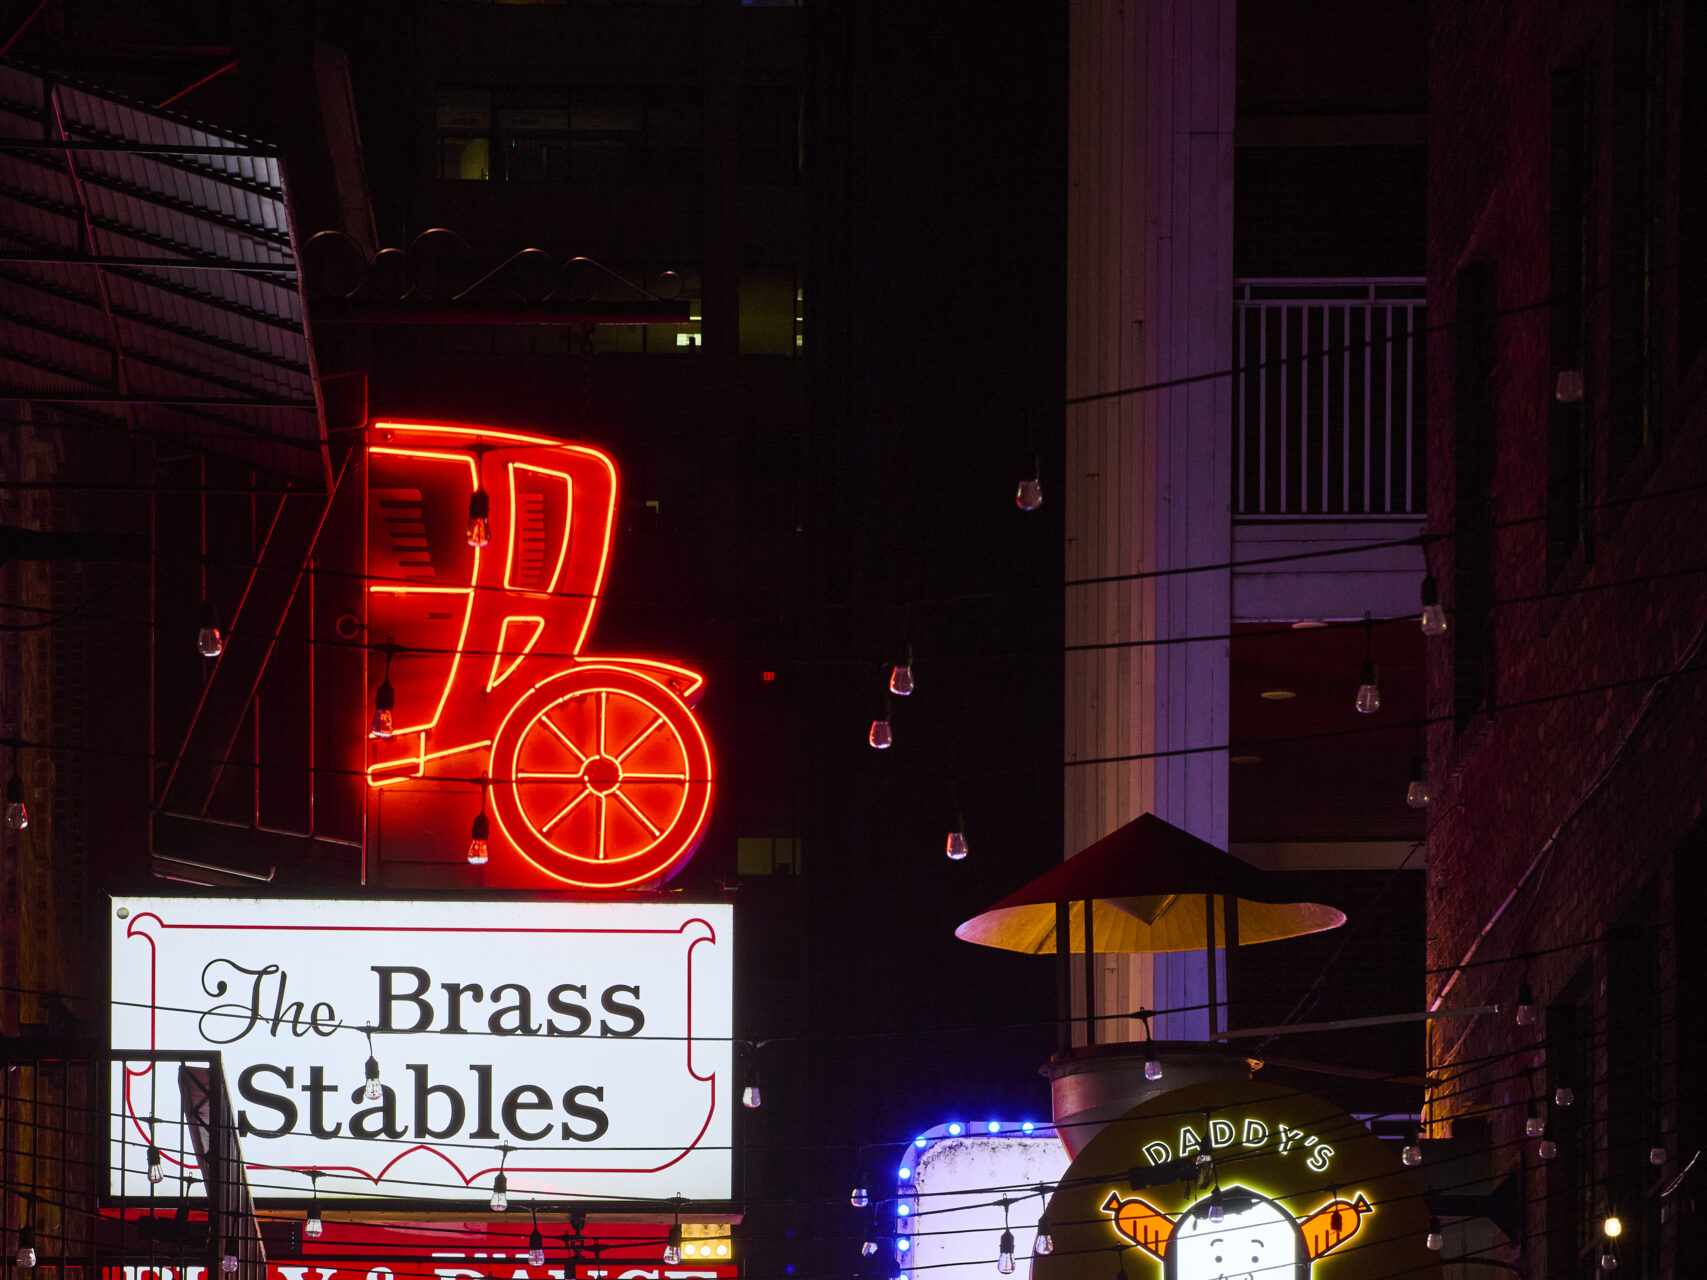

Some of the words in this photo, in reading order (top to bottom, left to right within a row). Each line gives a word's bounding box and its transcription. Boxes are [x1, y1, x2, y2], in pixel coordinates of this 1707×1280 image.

[199, 958, 342, 1044] The
[370, 964, 646, 1038] Brass
[236, 1062, 610, 1142] Stables
[1142, 1118, 1335, 1172] DADDY'S
